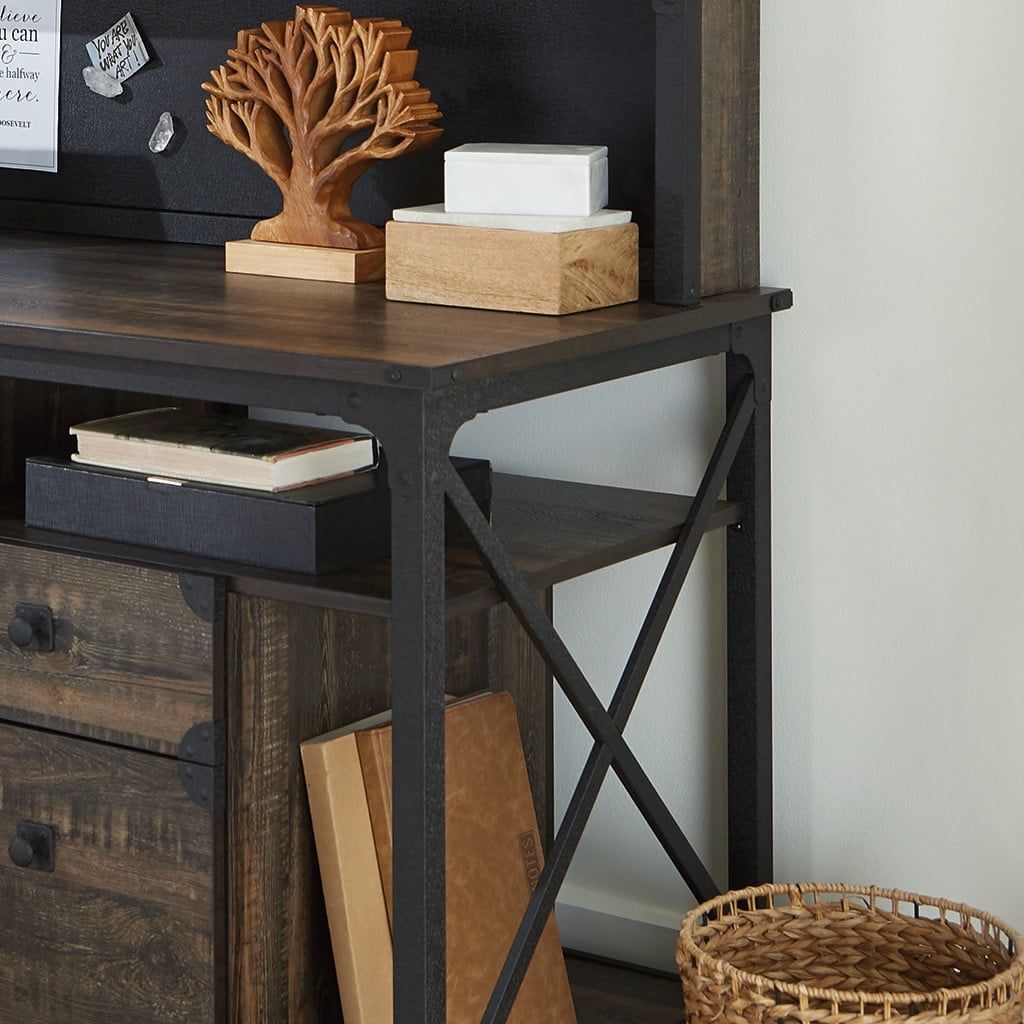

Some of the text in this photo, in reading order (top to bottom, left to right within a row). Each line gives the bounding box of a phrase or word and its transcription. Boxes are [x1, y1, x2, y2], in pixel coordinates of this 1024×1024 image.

[11, 28, 38, 42] can
[92, 20, 129, 59] YOU ARE
[1, 44, 17, 64] &
[100, 34, 136, 71] WHAT YOU
[6, 67, 40, 82] halfway
